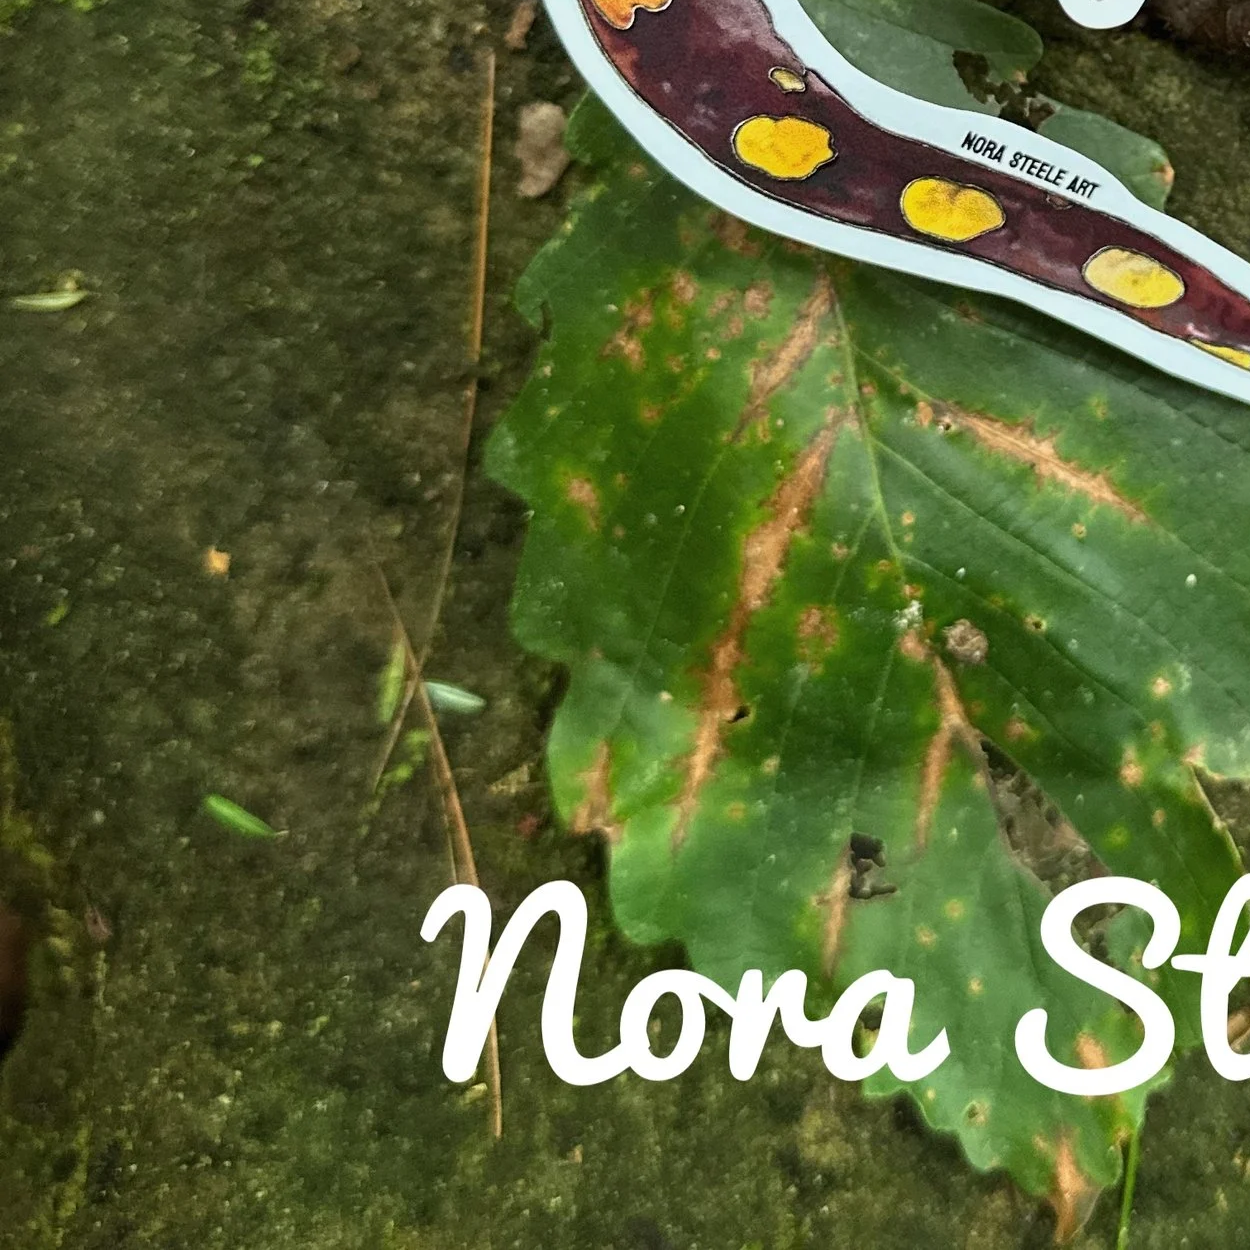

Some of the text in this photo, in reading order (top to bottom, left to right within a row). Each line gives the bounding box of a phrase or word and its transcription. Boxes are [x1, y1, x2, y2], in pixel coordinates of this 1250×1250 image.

[961, 131, 1100, 198] NORA STEELE ART
